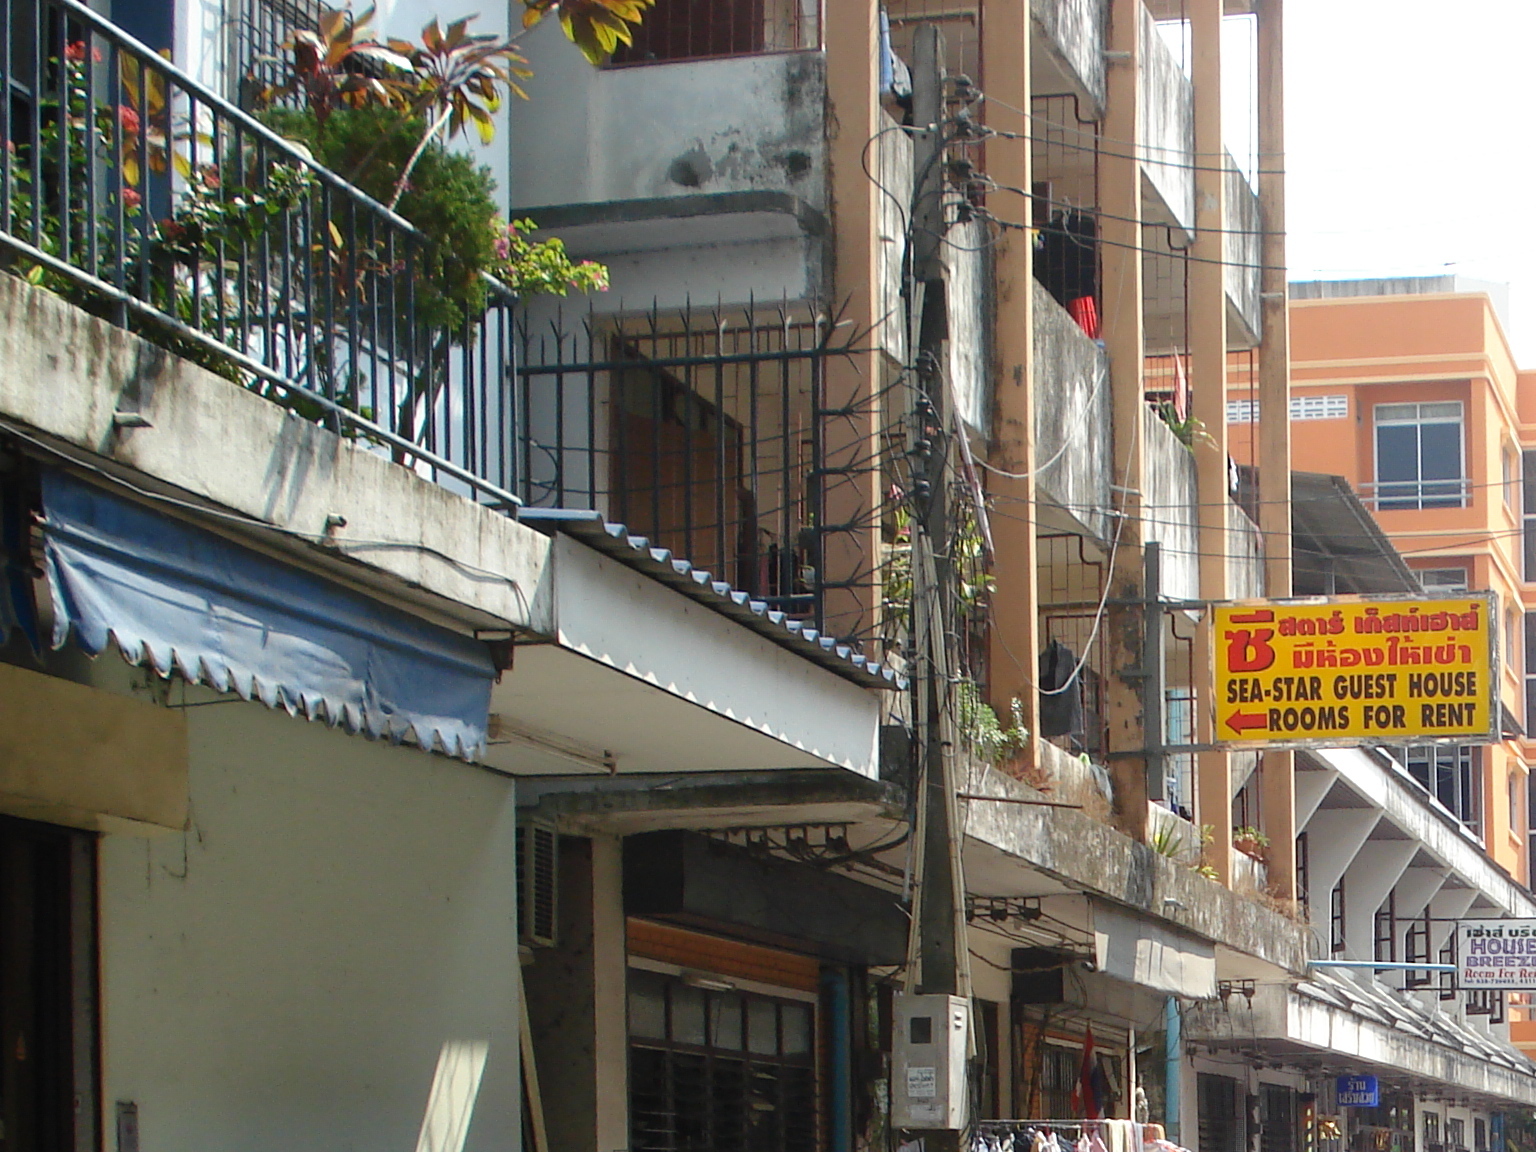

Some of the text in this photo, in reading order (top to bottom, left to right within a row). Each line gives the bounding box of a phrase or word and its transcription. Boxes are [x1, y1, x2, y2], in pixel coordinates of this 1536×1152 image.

[1224, 609, 1275, 672] ซี
[1278, 610, 1345, 637] สตาร์
[1293, 635, 1472, 669] มีห้องให้เช่า
[1226, 671, 1478, 704] SEA-STAR GUEST HOUSE
[1268, 702, 1477, 732] ROOMS FOR RENT
[1470, 938, 1536, 954] HOUSE
[1464, 968, 1495, 978] Room
[1499, 968, 1515, 978] For
